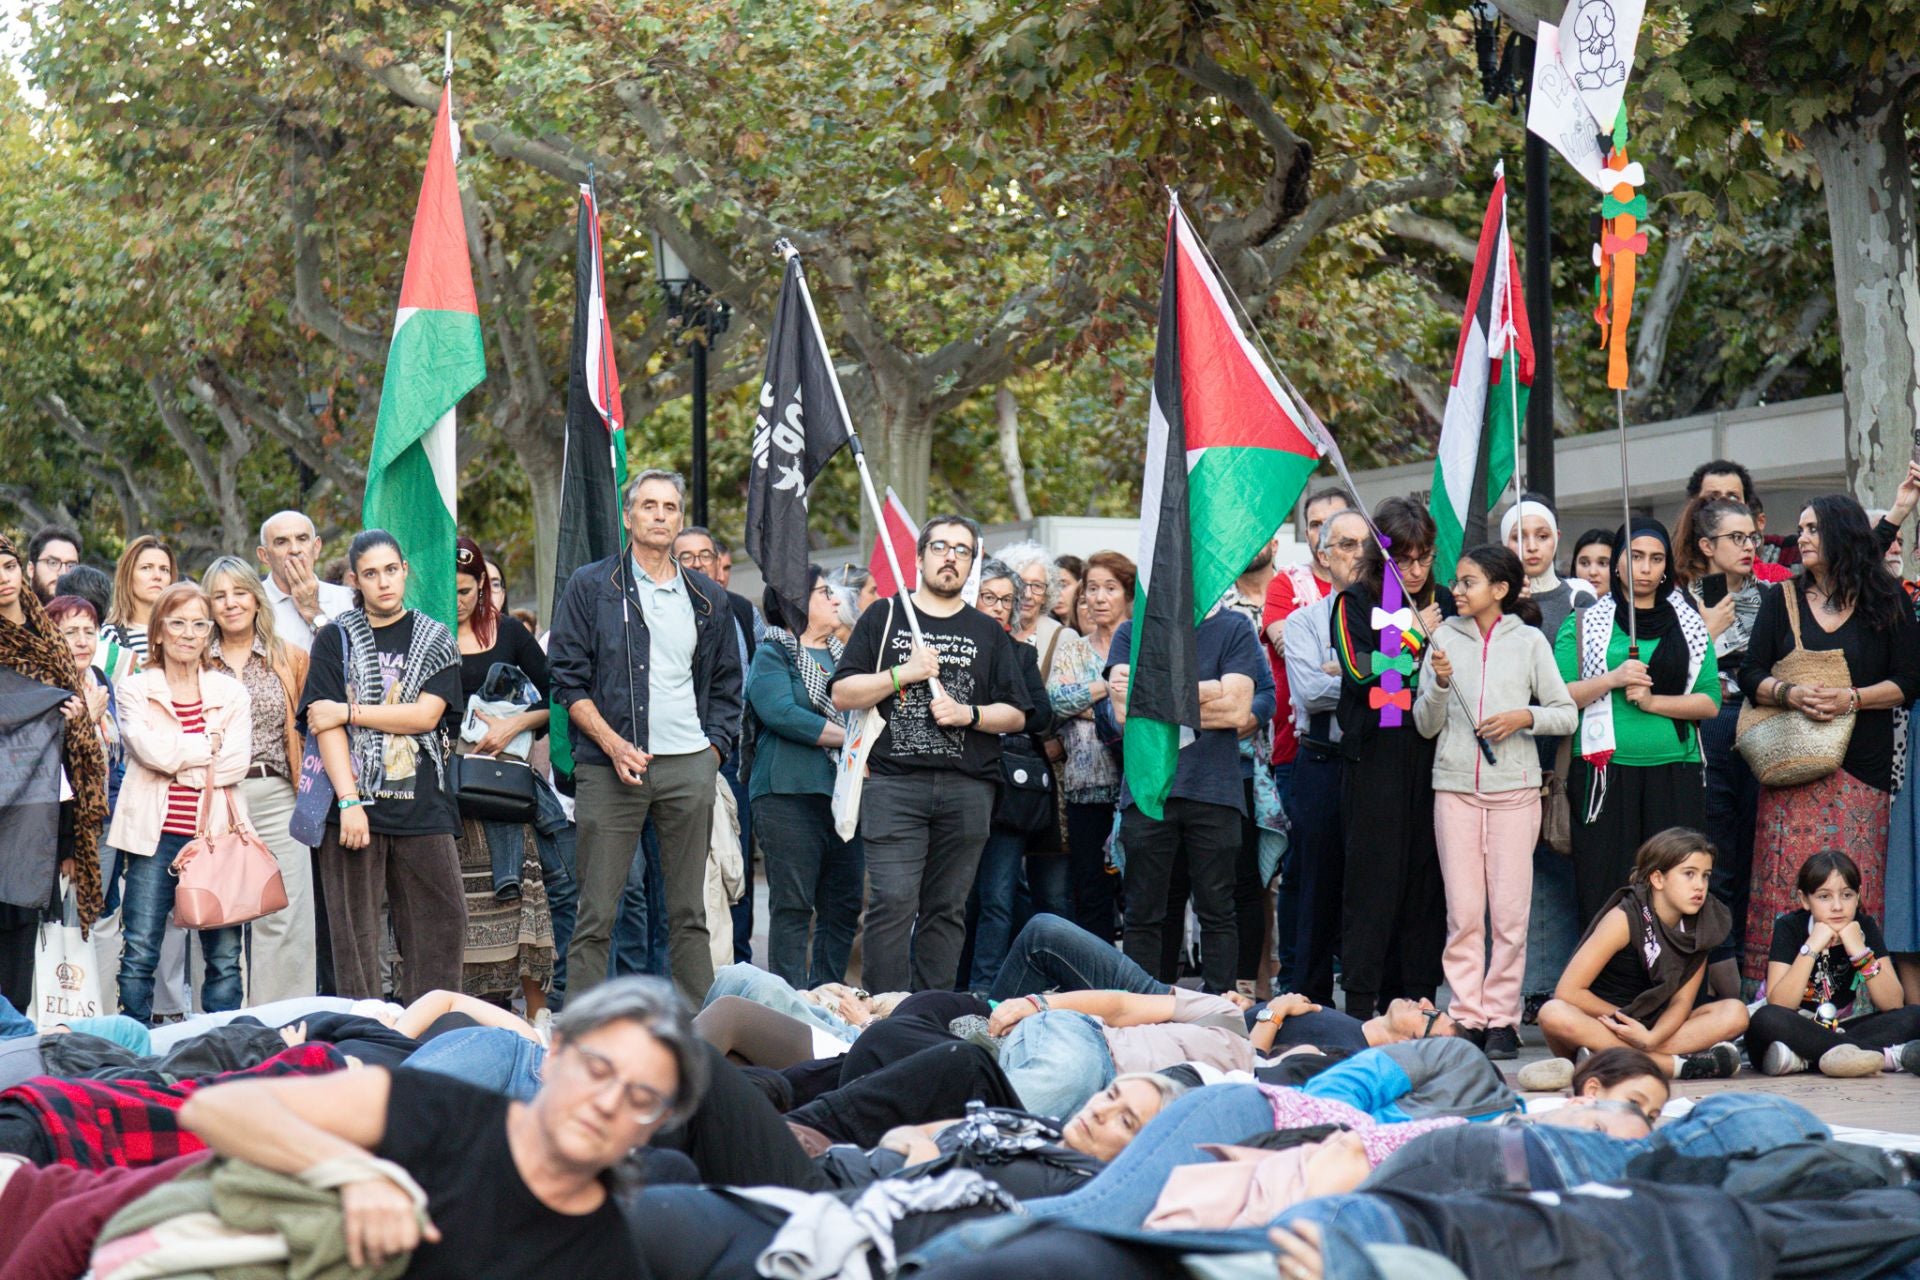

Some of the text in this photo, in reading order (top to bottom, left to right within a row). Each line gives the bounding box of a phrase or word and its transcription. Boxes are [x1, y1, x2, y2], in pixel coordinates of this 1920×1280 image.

[960, 645, 978, 659] cat
[375, 790, 393, 799] POP
[393, 790, 415, 799] STAR
[46, 995, 96, 1017] ELLAS
